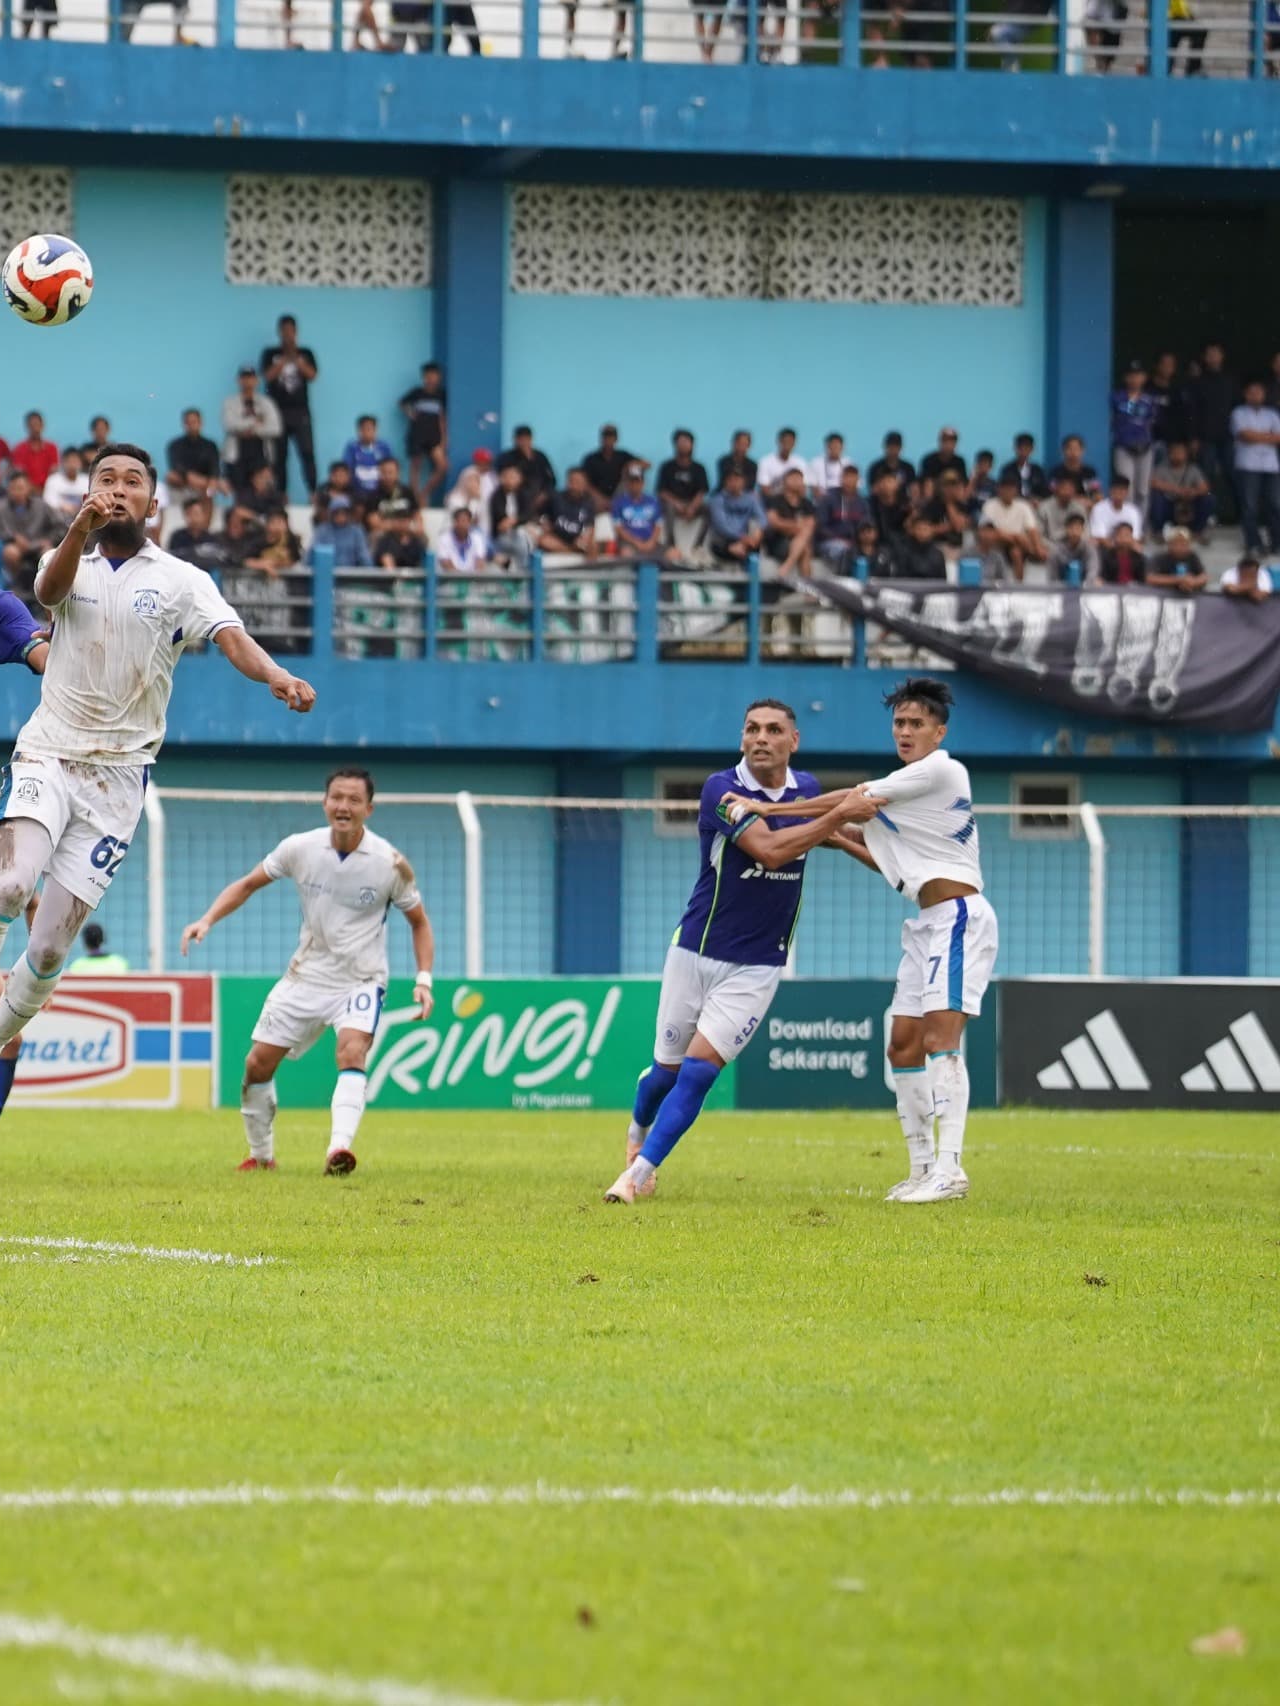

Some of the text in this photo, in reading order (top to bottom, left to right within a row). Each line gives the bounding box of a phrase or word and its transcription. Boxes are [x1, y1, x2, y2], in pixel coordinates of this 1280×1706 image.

[90, 834, 129, 878] 62
[928, 955, 942, 985] 7
[346, 993, 372, 1014] 10
[769, 1017, 873, 1041] Download
[768, 1047, 869, 1079] Sekarang
